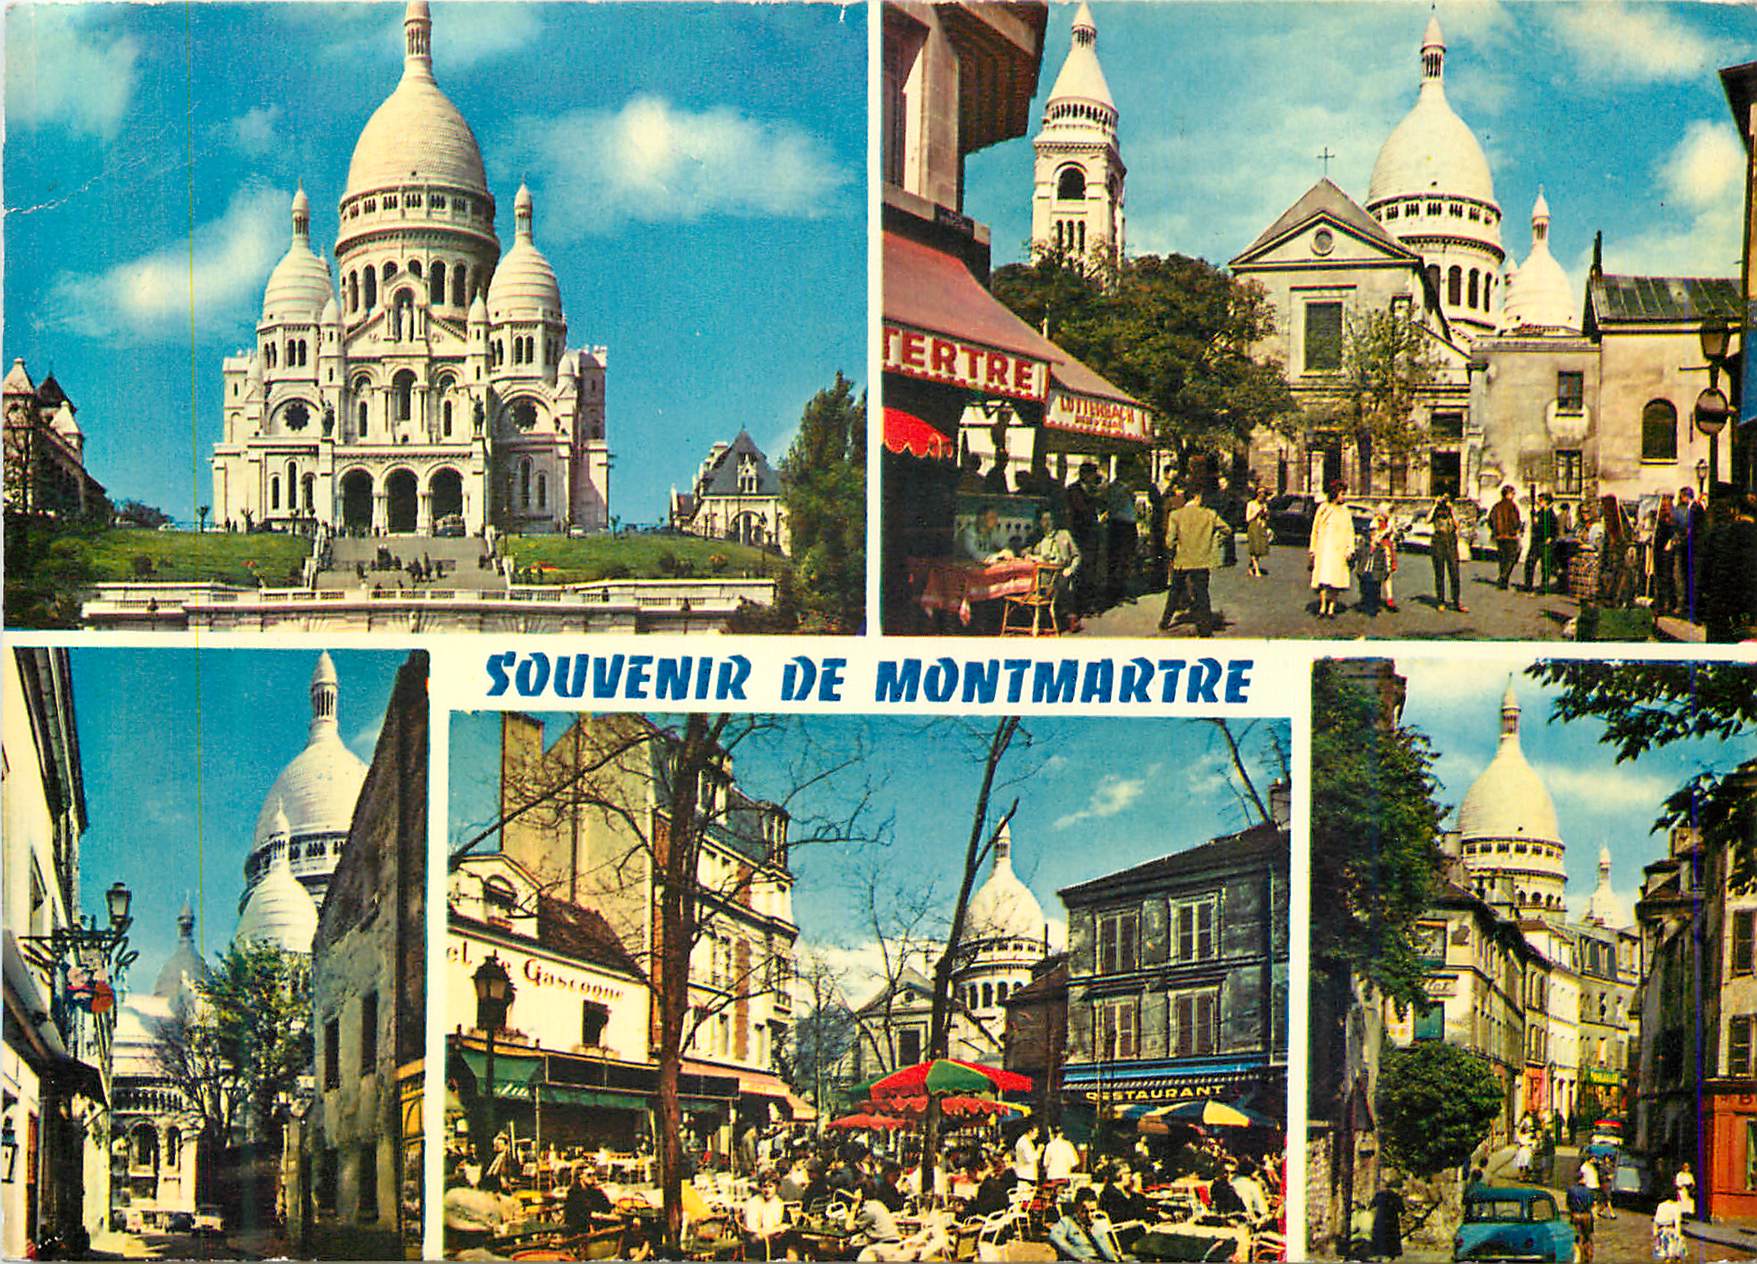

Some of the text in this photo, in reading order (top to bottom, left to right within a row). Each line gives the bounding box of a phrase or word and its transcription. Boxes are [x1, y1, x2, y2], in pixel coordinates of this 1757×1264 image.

[883, 327, 1034, 391] TERTRE
[1060, 394, 1135, 424] LUTTERBACH
[523, 957, 625, 1002] Gascogne
[1085, 1085, 1226, 1101] RESTAURANT
